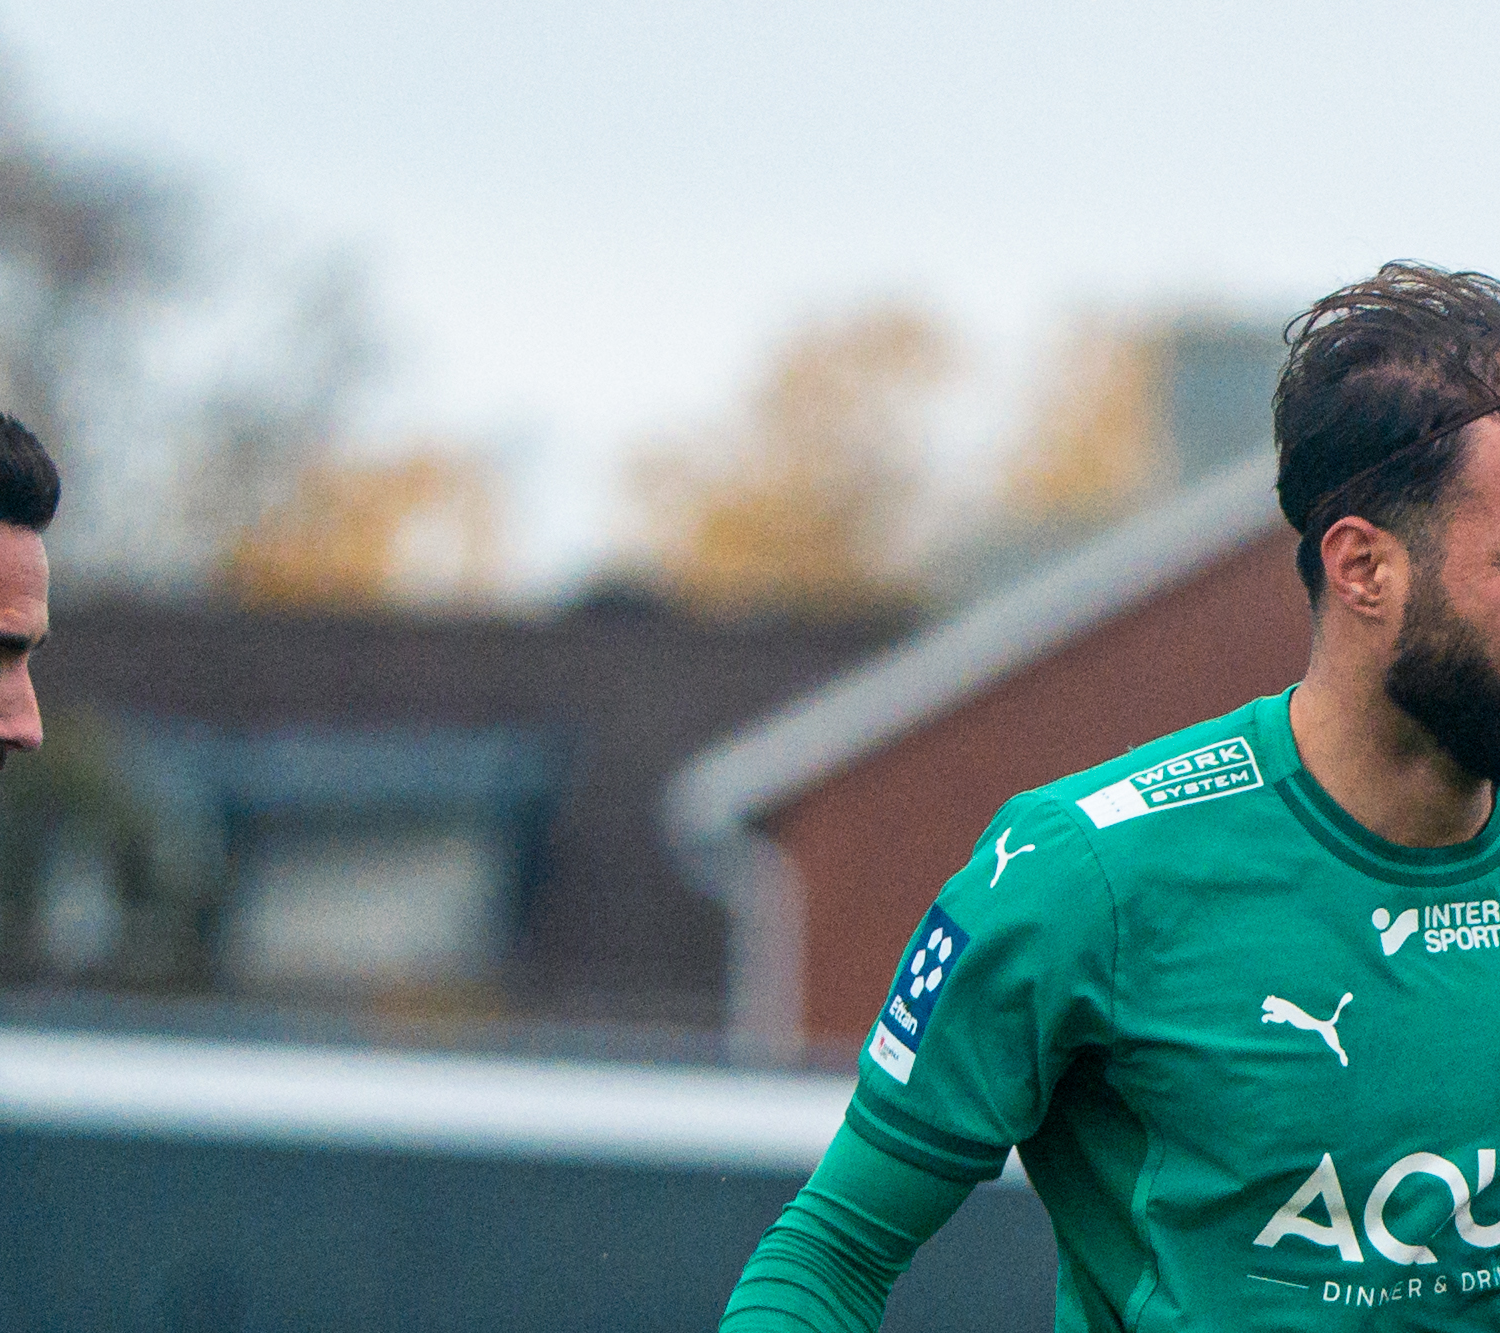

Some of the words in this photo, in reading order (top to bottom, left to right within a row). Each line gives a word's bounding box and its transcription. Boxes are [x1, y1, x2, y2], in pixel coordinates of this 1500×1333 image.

[1135, 745, 1244, 785] WORK
[1150, 770, 1249, 803] SYSTEM
[1424, 899, 1500, 929] INTER
[888, 994, 918, 1036] Ettan
[1323, 1278, 1421, 1308] DINNER
[1434, 1276, 1447, 1294] &
